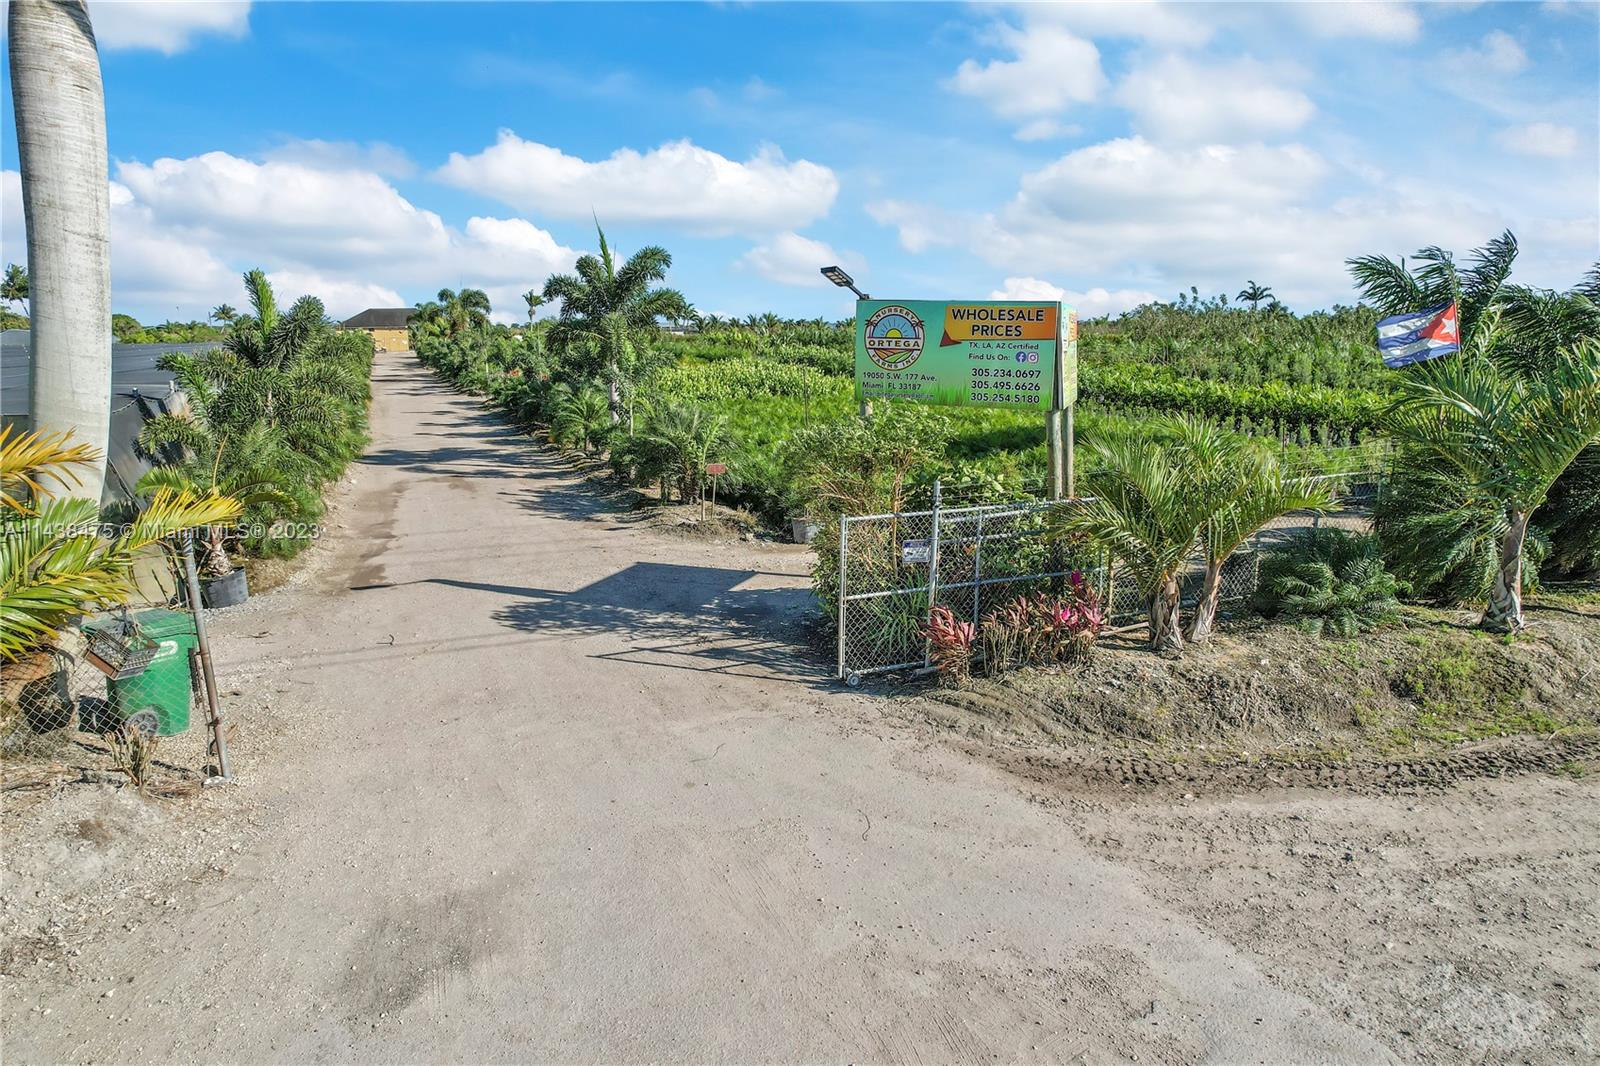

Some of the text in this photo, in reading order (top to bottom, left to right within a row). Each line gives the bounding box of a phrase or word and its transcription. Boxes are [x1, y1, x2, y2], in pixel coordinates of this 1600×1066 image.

[875, 308, 916, 321] NURSERY
[952, 308, 1044, 322] WHOLESALE
[971, 325, 1022, 337] PRICES
[872, 354, 899, 368] FARMS
[971, 368, 1041, 378] 305.234.0697
[971, 381, 1040, 391] 305.495.6626
[970, 393, 1040, 403] 305.254.5180
